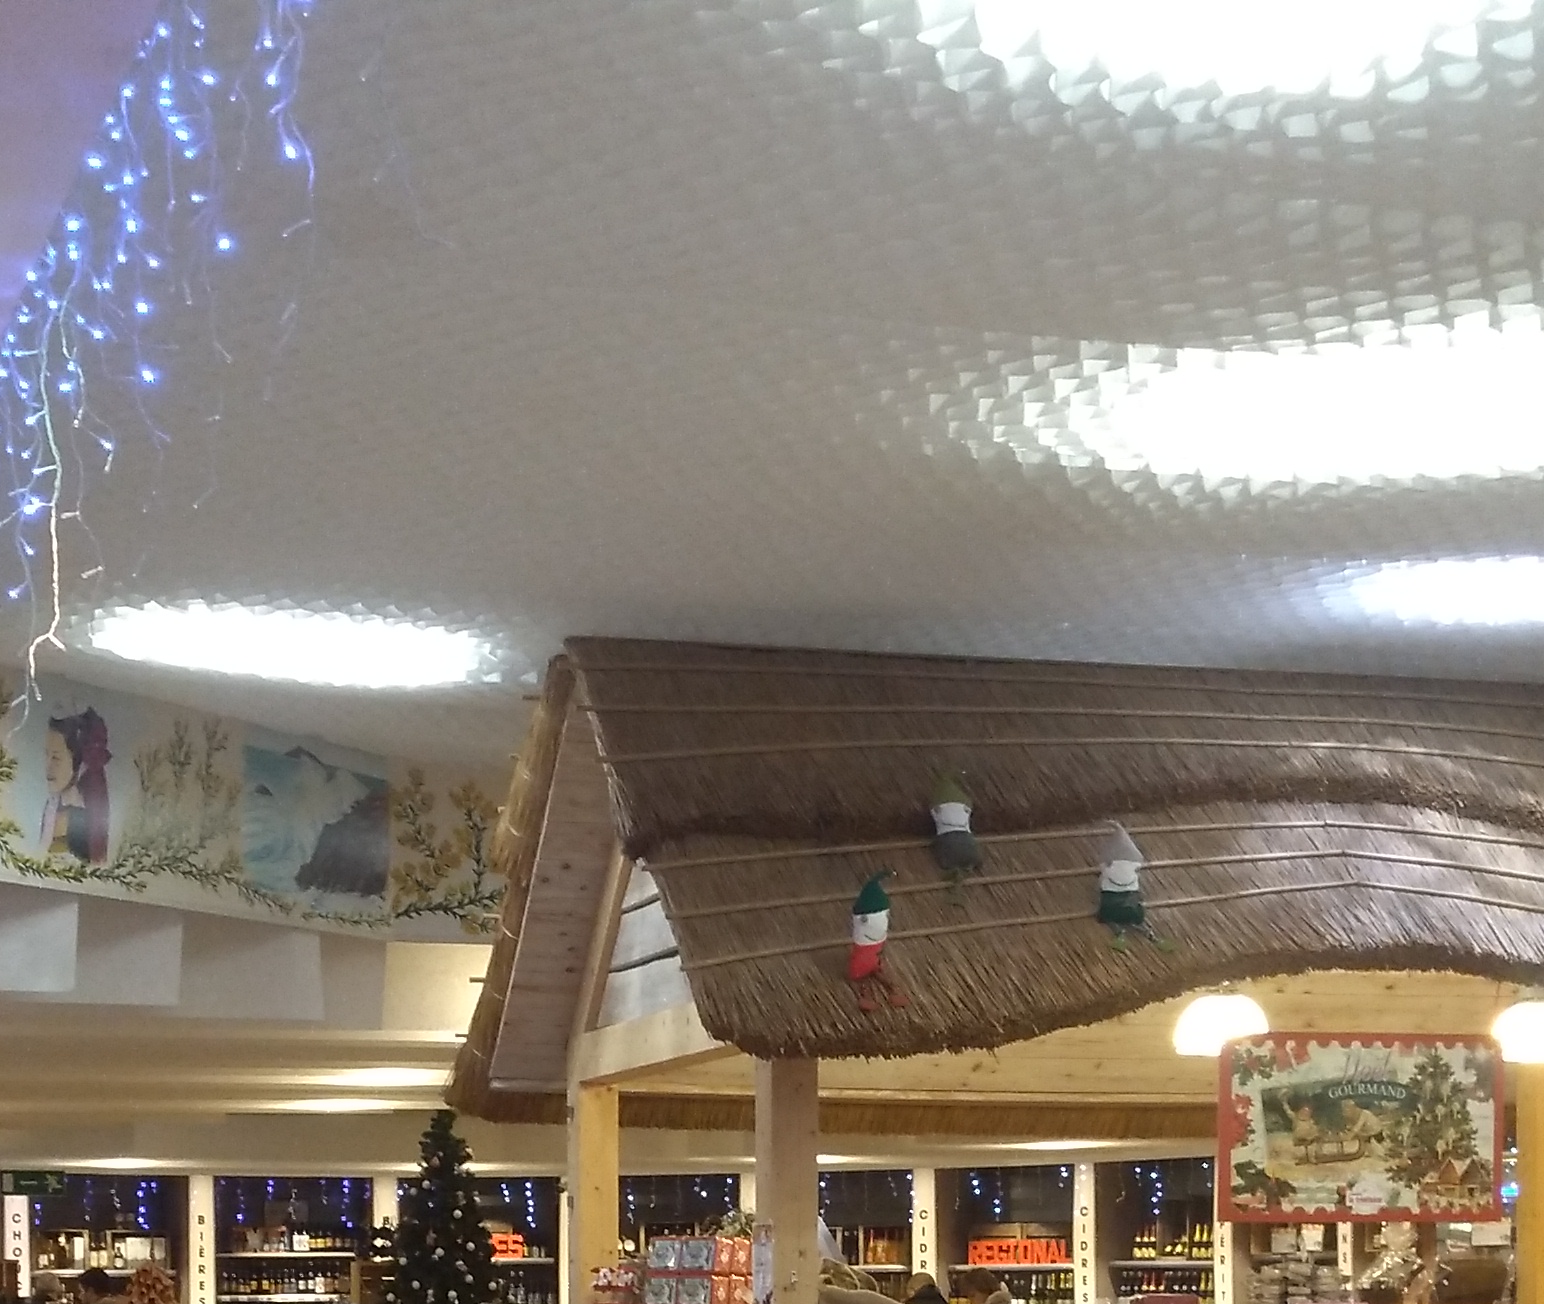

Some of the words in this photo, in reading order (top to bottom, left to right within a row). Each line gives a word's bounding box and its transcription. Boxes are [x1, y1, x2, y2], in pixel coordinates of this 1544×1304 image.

[1328, 1083, 1406, 1099] GOURMAND
[968, 1238, 1073, 1266] REGIONAL
[1079, 1206, 1089, 1303] CIDRES
